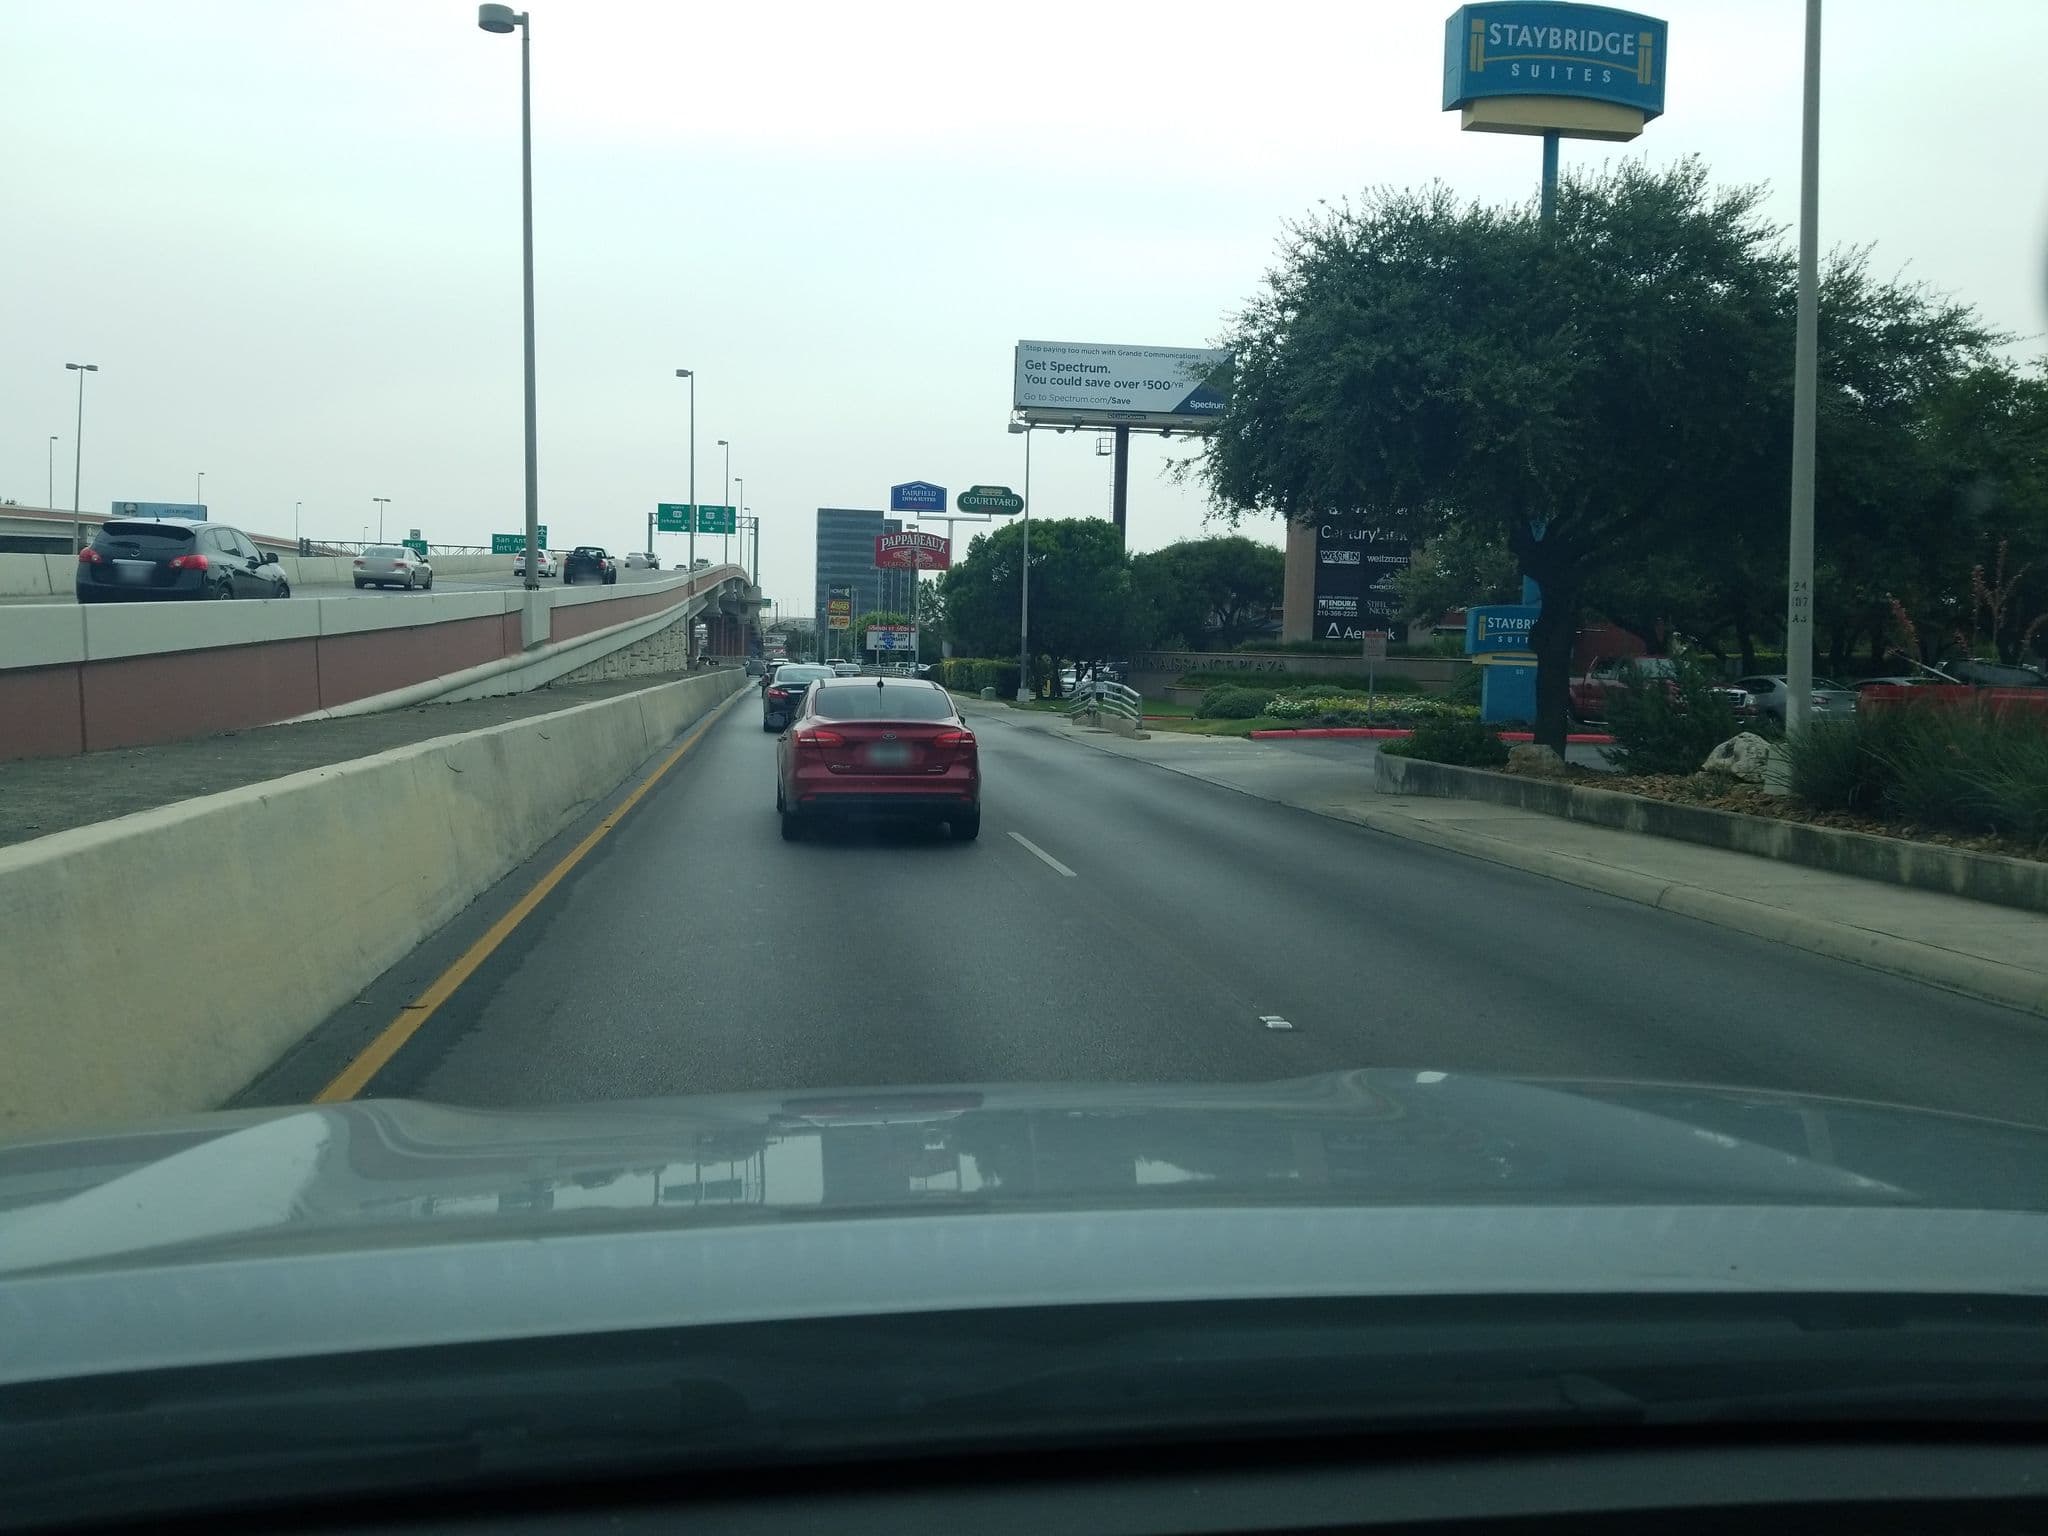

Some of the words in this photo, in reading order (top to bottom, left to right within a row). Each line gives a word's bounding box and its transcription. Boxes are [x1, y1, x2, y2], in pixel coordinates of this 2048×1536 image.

[1489, 22, 1635, 56] STAYBRIDGE
[1511, 63, 1612, 83] SUITES
[1025, 360, 1047, 371] Get
[1050, 361, 1111, 374] Spectrum.
[1024, 374, 1047, 384] You
[1050, 376, 1082, 387] could
[1085, 380, 1111, 388] save
[1114, 380, 1140, 389] over
[1024, 392, 1036, 401] Go
[1039, 393, 1047, 401] to
[902, 488, 937, 497] FAIRFIELD
[963, 496, 1018, 507] COURTYARD
[881, 535, 946, 554] PAPPADEAUX
[1488, 617, 1538, 630] STAYBRI
[1344, 626, 1395, 640] Aerk
